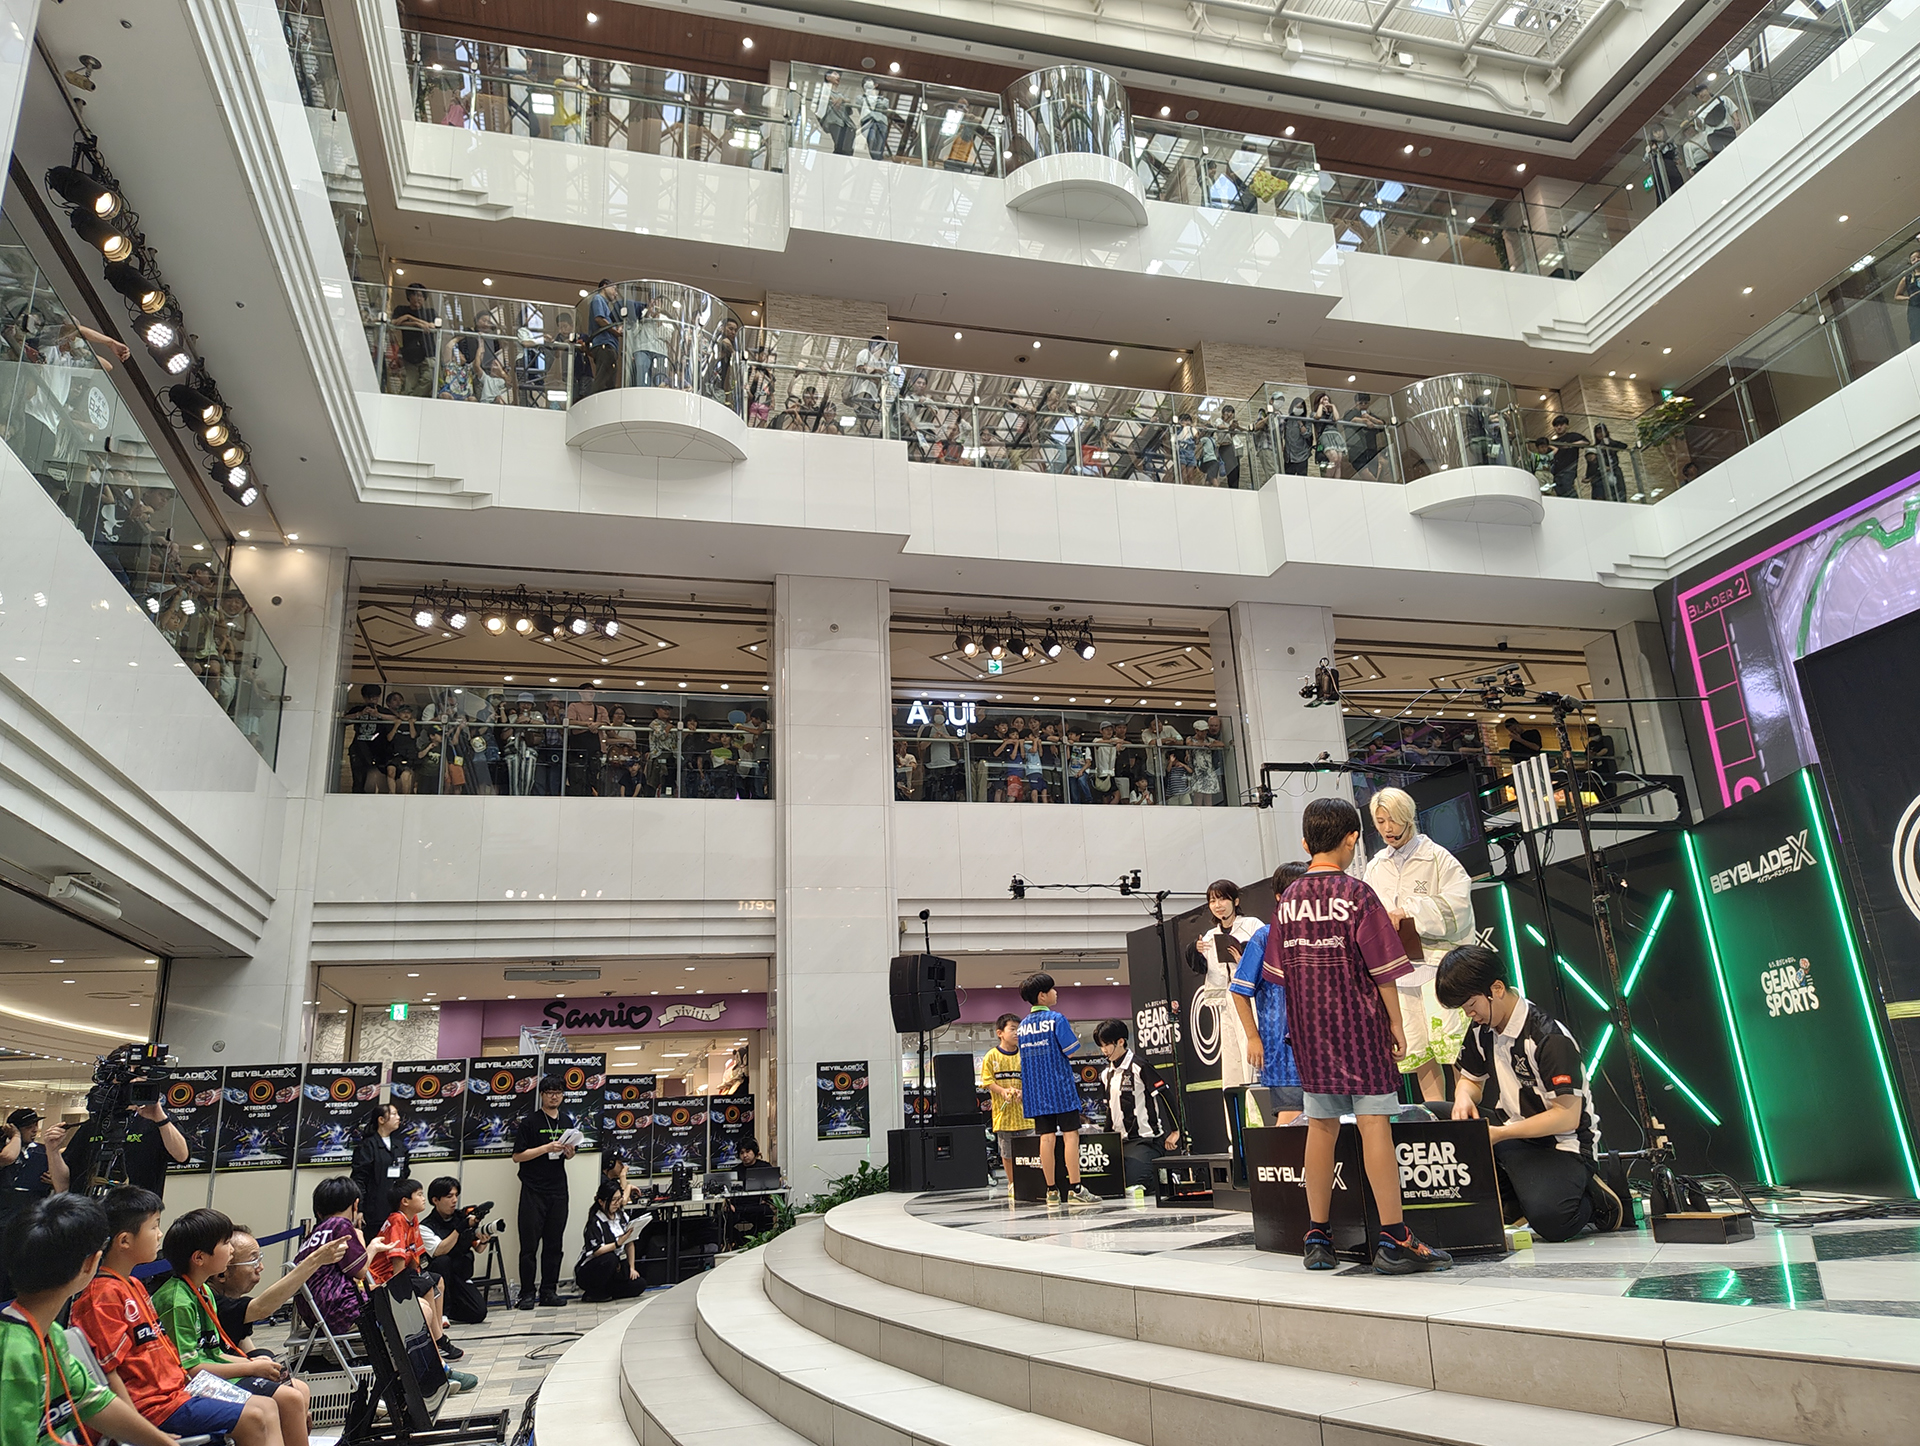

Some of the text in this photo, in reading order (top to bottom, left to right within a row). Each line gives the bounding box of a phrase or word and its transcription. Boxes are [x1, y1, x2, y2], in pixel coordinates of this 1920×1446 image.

[1688, 577, 1748, 619] BLADER 2
[1761, 965, 1801, 995] GEAR
[1766, 985, 1820, 1018] SPORTS
[542, 1001, 653, 1030] Sanrio
[1017, 1019, 1056, 1036] NALIST
[1136, 1006, 1168, 1030] GEAR
[1138, 1023, 1181, 1048] SPORTS
[1015, 1156, 1042, 1166] BEYBLADE
[1078, 1154, 1110, 1168] ORTS
[1079, 1143, 1103, 1155] EAR
[1395, 1141, 1458, 1166] GEAR
[1398, 1163, 1471, 1189] PORTS
